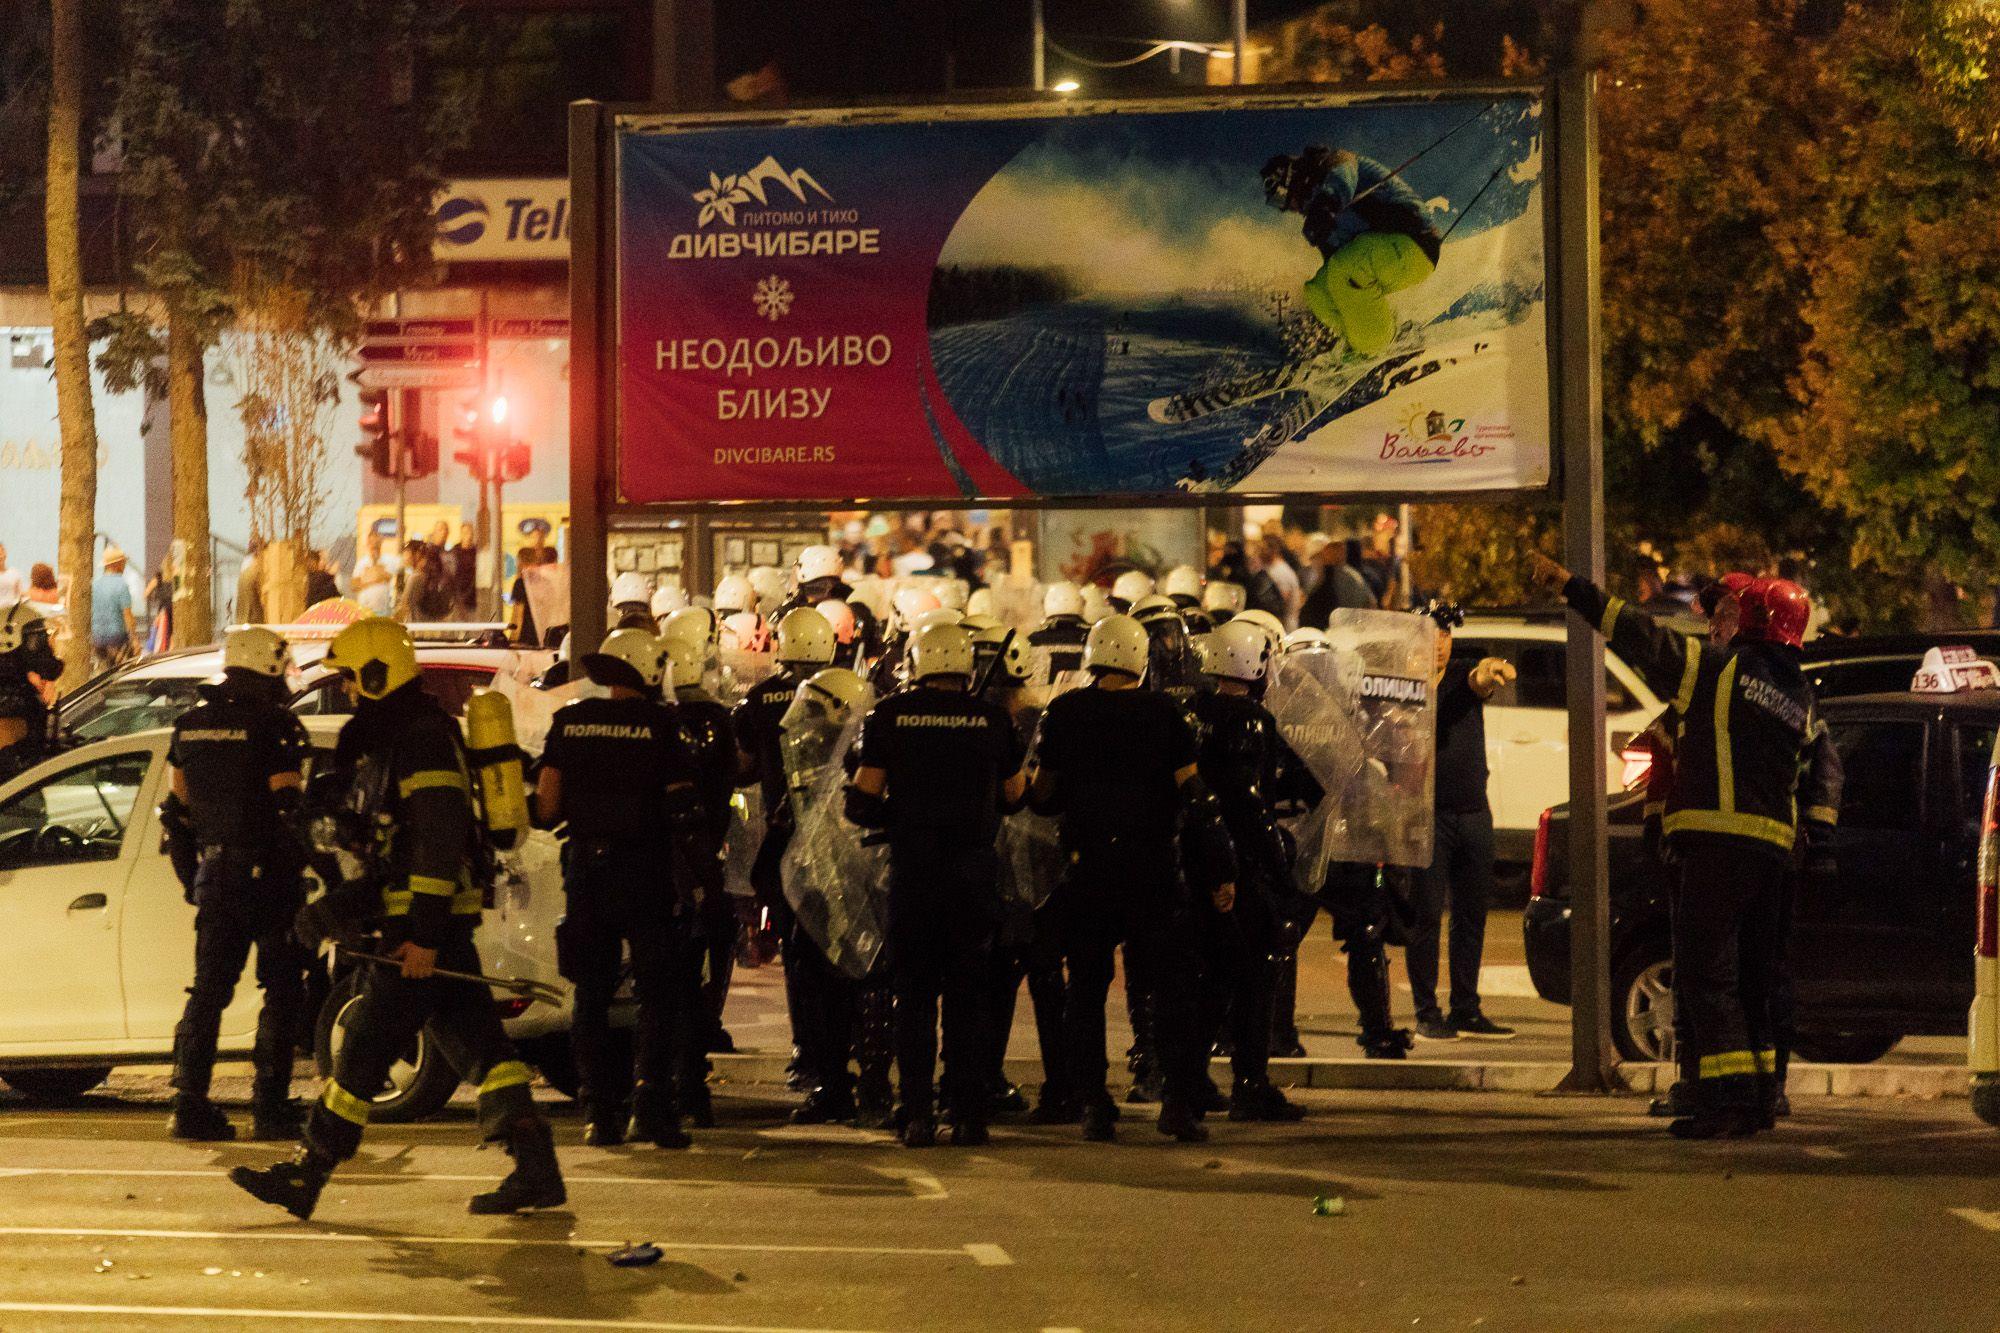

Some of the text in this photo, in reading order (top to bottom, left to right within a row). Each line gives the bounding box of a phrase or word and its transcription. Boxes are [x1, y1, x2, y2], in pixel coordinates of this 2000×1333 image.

[504, 199, 570, 242] Tel
[743, 209, 858, 226] ПИТОМО И ТИХО
[667, 229, 880, 259] ДИВЧИБАРЕ
[655, 334, 892, 376] НЕОДОЉИВО
[717, 387, 832, 420] БЛИЗУ
[714, 447, 836, 465] DIVCIBARE.RS
[1914, 673, 1939, 689] 136
[762, 690, 797, 705] ПОЛ
[896, 715, 989, 729] ПОЛИЦИЈА
[563, 724, 652, 739] ПОЛИЦИЈА
